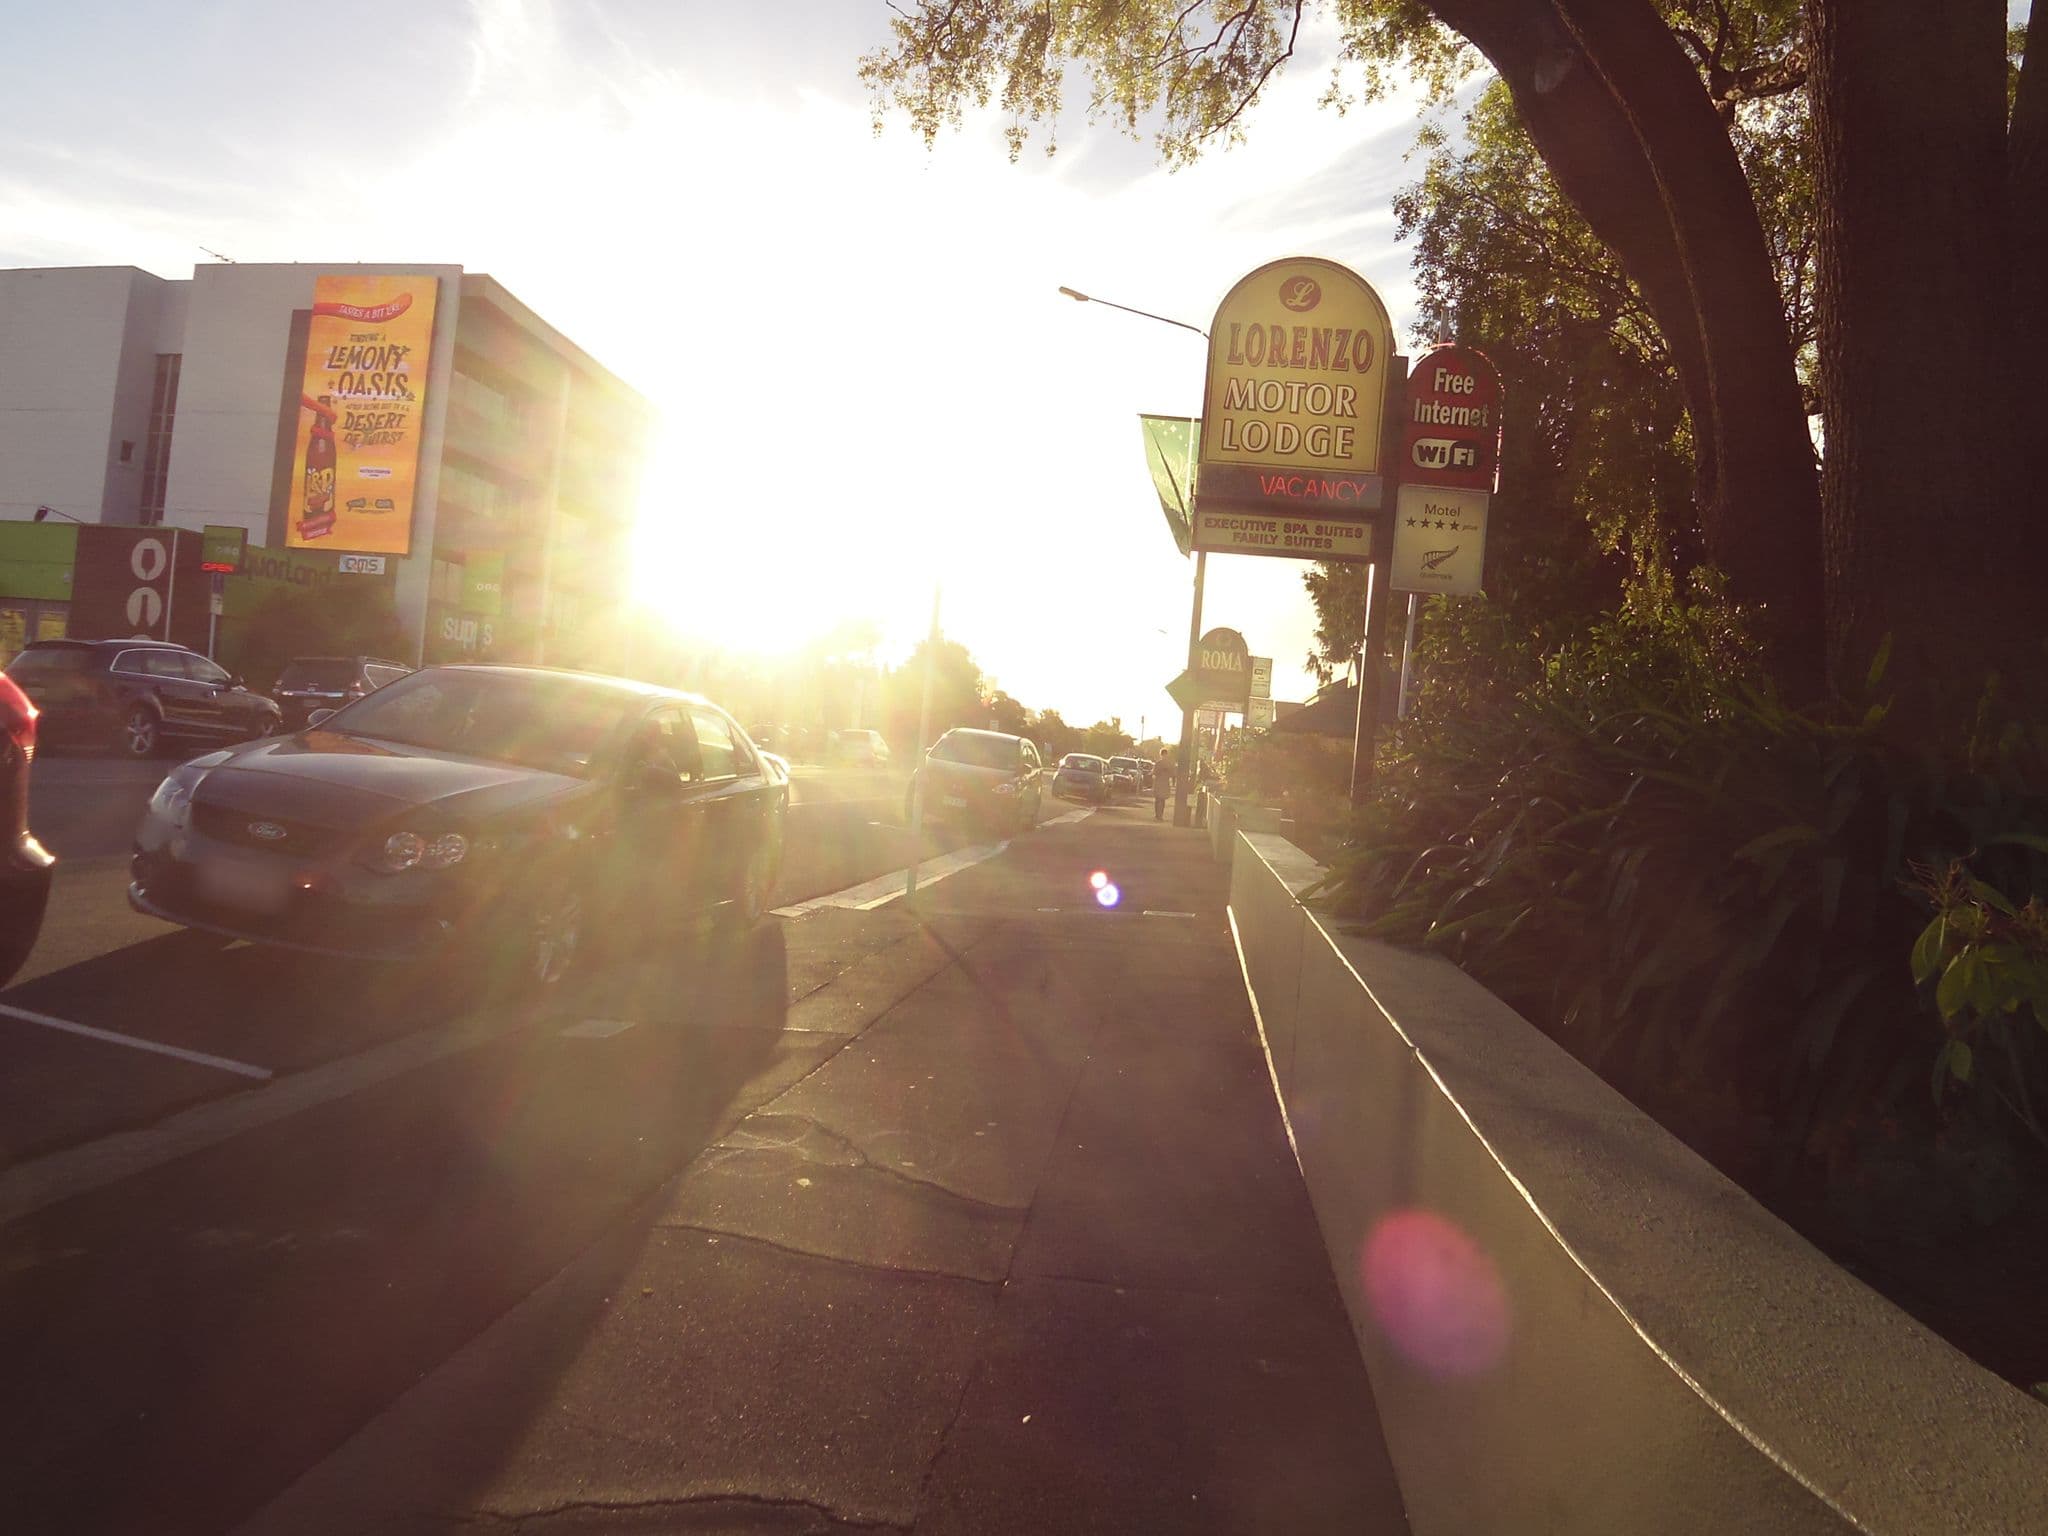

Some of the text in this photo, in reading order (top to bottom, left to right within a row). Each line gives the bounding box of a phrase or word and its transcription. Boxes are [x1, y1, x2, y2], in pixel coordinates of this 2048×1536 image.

[327, 344, 411, 372] LEMONY
[1226, 323, 1374, 374] LORENZO
[337, 371, 409, 396] OASIS
[1434, 367, 1474, 394] Free
[1223, 377, 1358, 418] MOTOR
[342, 411, 407, 431] DESERT
[1414, 398, 1489, 427] Internet
[1221, 418, 1354, 459] LODGE
[1260, 474, 1368, 501] VACANCY
[1424, 503, 1461, 517] Motel
[1204, 517, 1363, 539] EXECUTIVE SPA SUITES
[1233, 532, 1332, 549] FAMILY SUITES
[1201, 650, 1243, 672] ROMA
